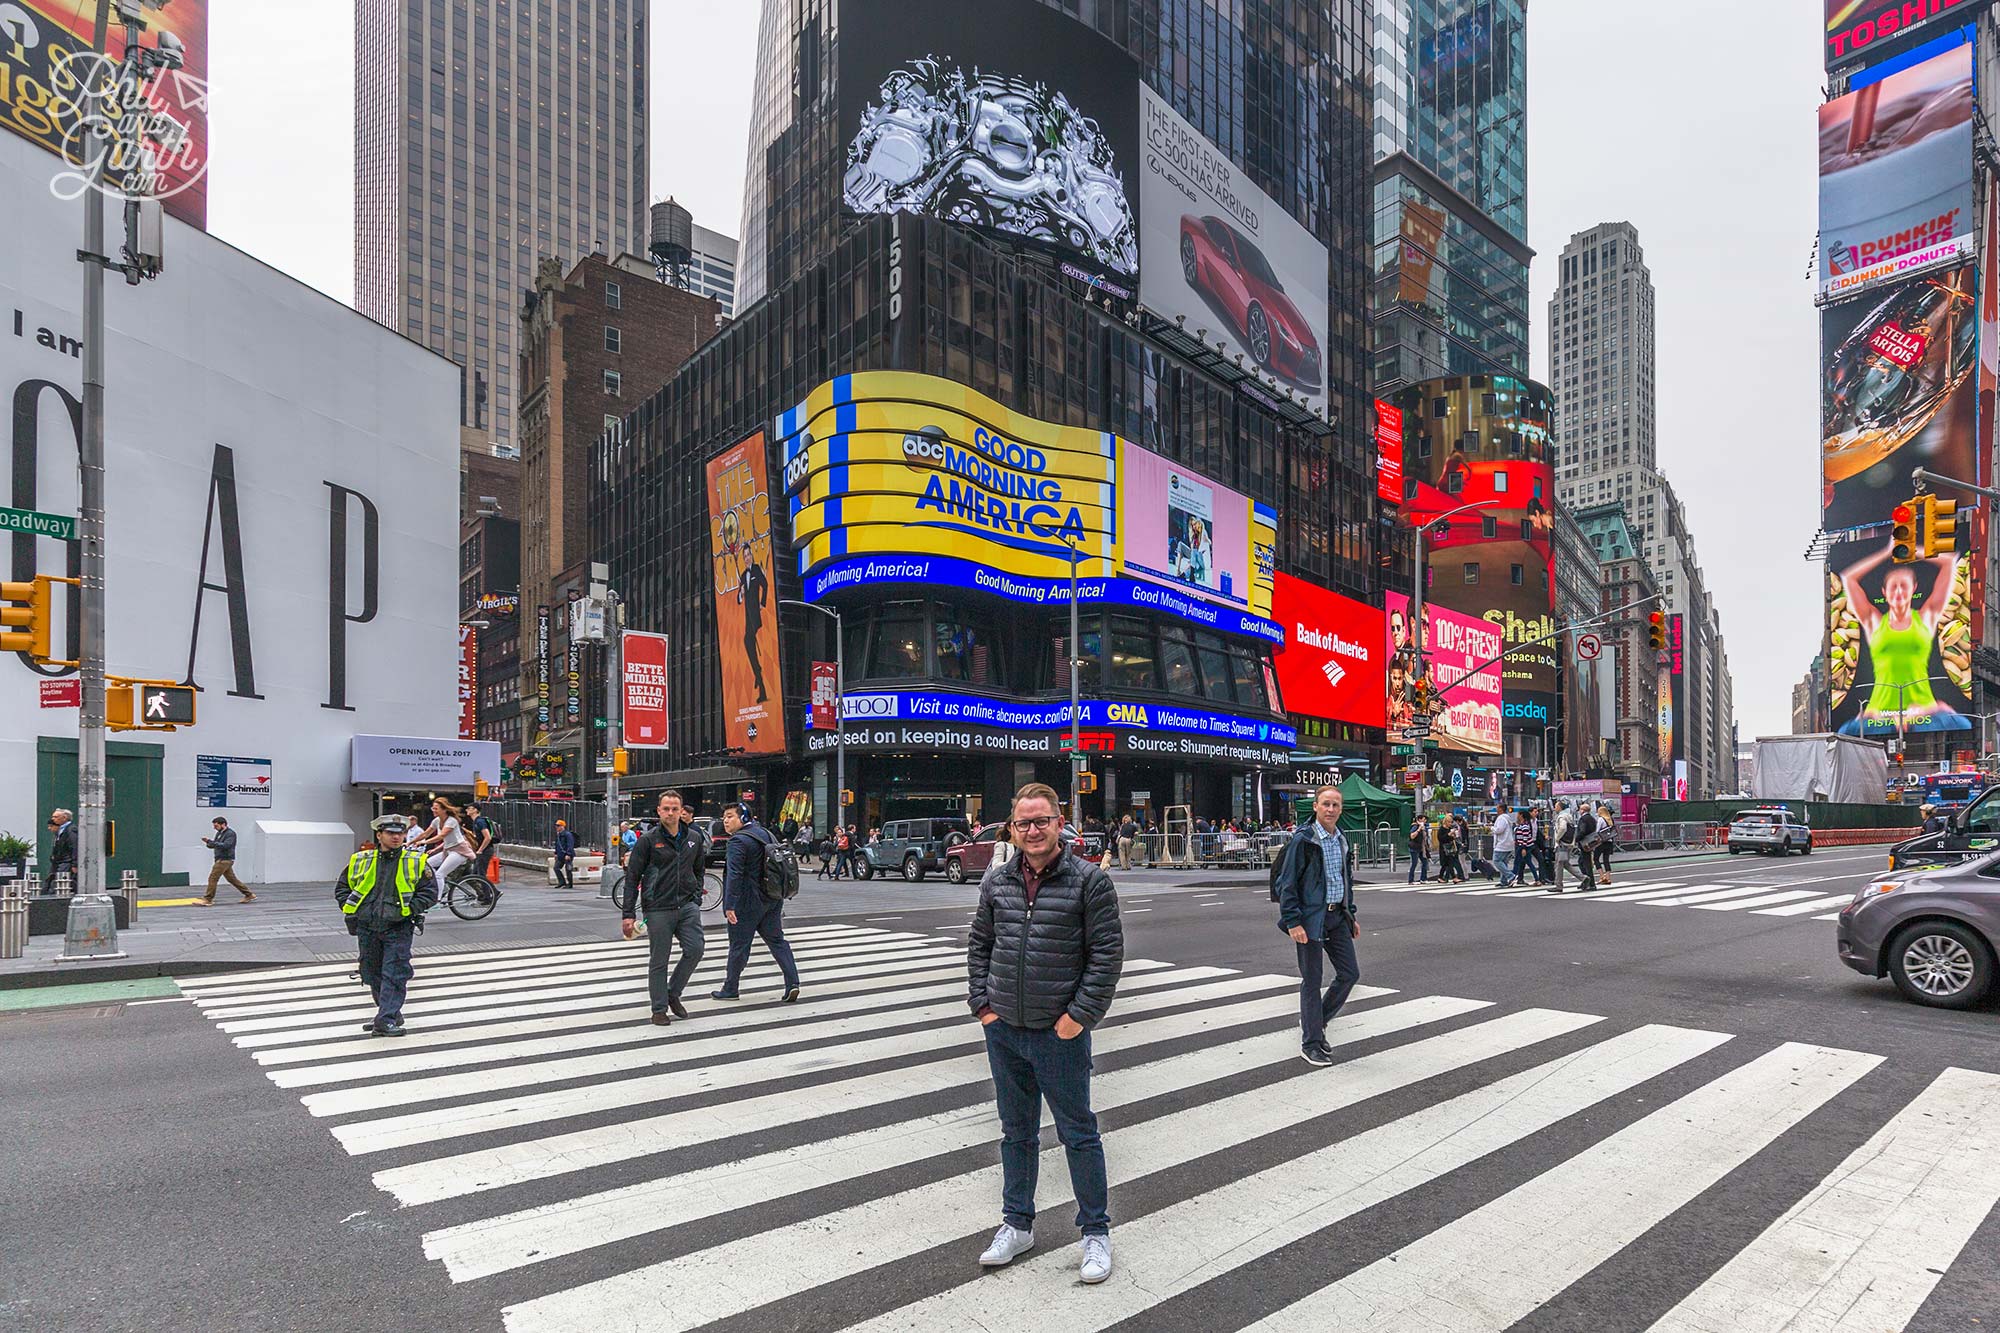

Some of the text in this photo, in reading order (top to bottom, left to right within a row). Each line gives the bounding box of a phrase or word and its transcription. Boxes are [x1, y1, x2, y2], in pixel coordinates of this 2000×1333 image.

[1829, 0, 1961, 57] TOSHI
[1892, 20, 1928, 38] TOSHIBA
[1146, 97, 1230, 187] THE FIRST-EVER
[1147, 121, 1258, 230] LC 500 HAS ARRIVED
[1162, 167, 1197, 203] LEXUS
[1861, 207, 1960, 256] DUNKIN'
[889, 214, 902, 321] 1500
[14, 309, 23, 336] I
[1870, 335, 1914, 363] ARTOIS
[1880, 325, 1920, 353] STELLA
[903, 435, 944, 460] abc
[974, 427, 1046, 473] GOOD
[716, 459, 756, 514] THE
[945, 446, 1062, 502] MORNING
[915, 474, 1086, 542] AMERICA
[816, 561, 929, 594] Good Morning America!
[974, 569, 1000, 590] Good
[1000, 580, 1045, 602] Morning
[476, 596, 519, 610] VIRGIL'S
[1132, 585, 1159, 604] Good
[1160, 591, 1187, 616] Morning
[1187, 602, 1218, 623] America!
[1240, 617, 1281, 640] Good Morning
[1296, 622, 1369, 662] Bank of America
[1436, 618, 1500, 663] 100% FRESH
[1671, 616, 1682, 651] Locker
[627, 662, 664, 675] BETTE
[1465, 655, 1473, 669] ON
[50, 681, 75, 689] STOPPING
[624, 673, 666, 686] MIDLER
[628, 685, 664, 698] HELLO,
[1437, 662, 1500, 695] ROTTEN TOMATOES
[628, 696, 664, 708] DOLLY!
[838, 697, 895, 715] AHOO!
[910, 697, 941, 715] Visit
[944, 701, 959, 715] us
[963, 700, 995, 720] online:
[1880, 709, 1920, 717] Wonrful
[747, 726, 757, 737] abc
[1107, 704, 1148, 723] GMA
[1157, 711, 1199, 730] Welcome
[1199, 720, 1207, 730] to
[1209, 717, 1230, 734] Times
[1230, 720, 1256, 741] Square!
[1270, 727, 1286, 742] Follow
[1450, 710, 1499, 732] BABY DRIVER
[1867, 715, 1932, 728] PISTAHIOS
[389, 748, 429, 756] OPENING
[875, 730, 895, 744] on
[902, 728, 970, 748] keeping
[974, 734, 983, 746] a
[985, 734, 1008, 750] cool
[1011, 736, 1049, 750] head
[1128, 736, 1177, 752] Source:
[1180, 741, 1228, 758] Shumpert
[1229, 746, 1261, 763] requires
[1262, 748, 1271, 765] IV,
[1271, 751, 1285, 765] eyed
[547, 755, 562, 763] Deli
[227, 784, 270, 793] Schimenti
[1296, 770, 1343, 786] SEPHORA
